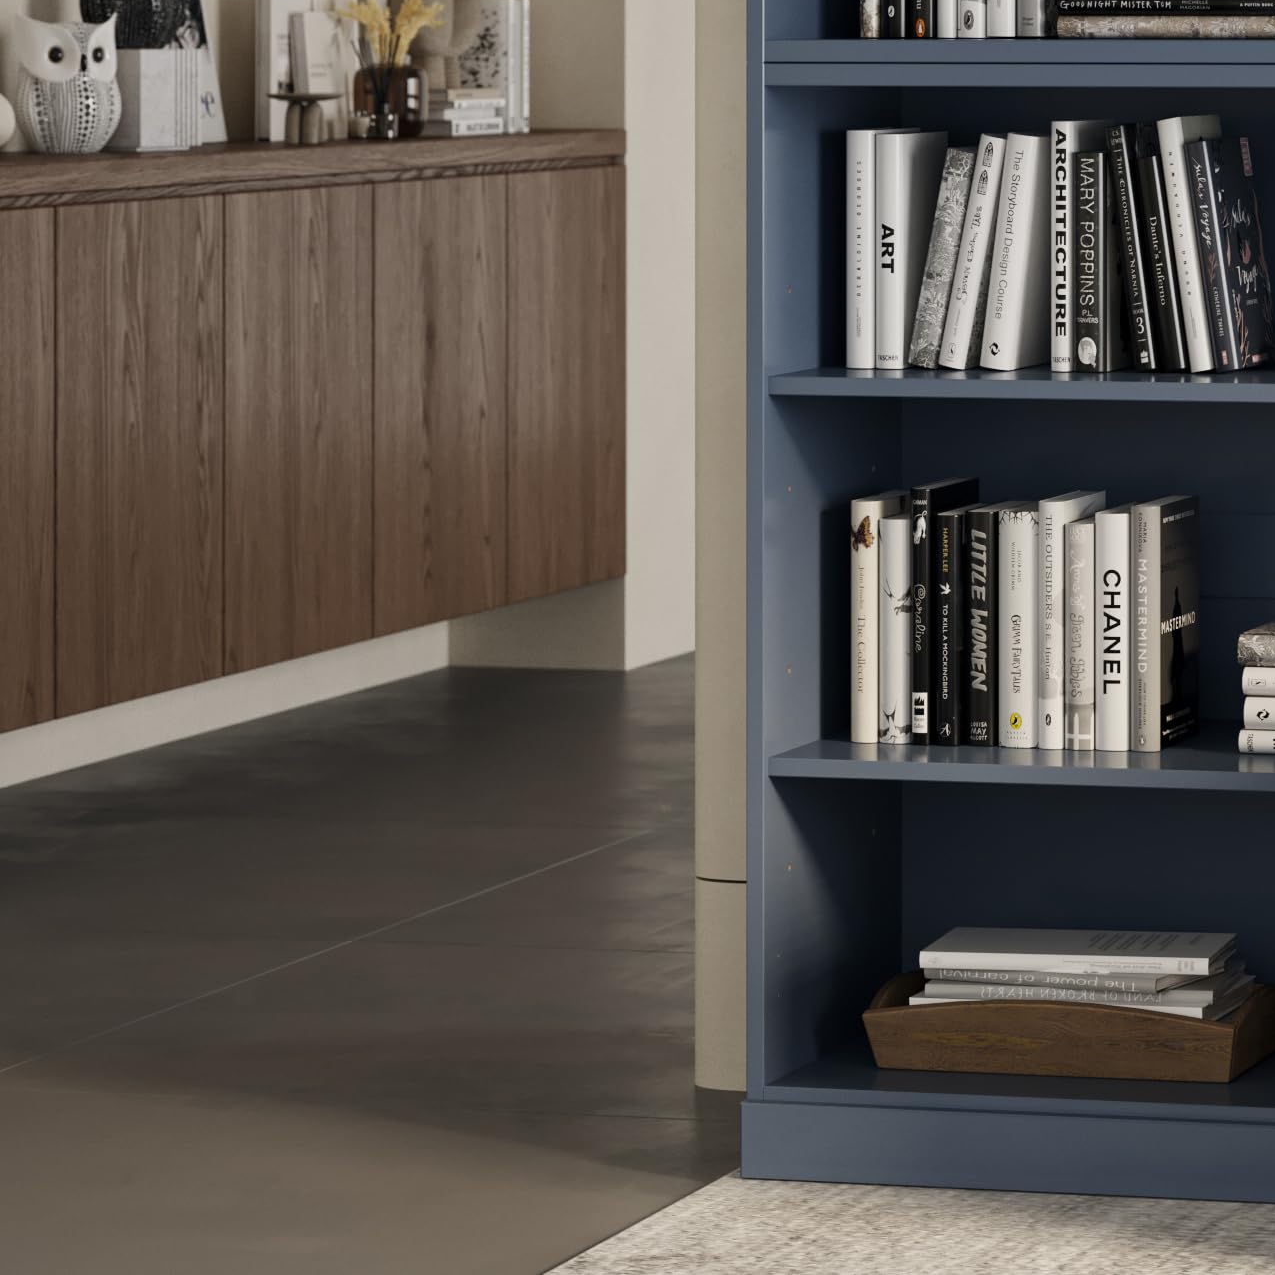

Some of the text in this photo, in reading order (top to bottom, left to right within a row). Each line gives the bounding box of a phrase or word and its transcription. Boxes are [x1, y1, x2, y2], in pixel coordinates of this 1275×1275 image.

[1120, 0, 1152, 9] MISTER
[1154, 0, 1172, 8] TOM
[881, 223, 895, 274] ART
[995, 149, 1024, 320] The Storyboard Design Course
[1055, 128, 1067, 337] ARCHITECTURE
[1080, 157, 1095, 306] MARY POPPINS
[1116, 156, 1140, 298] THE CHRONICLES OF NARNIA
[1197, 204, 1213, 249] Voyage
[1148, 216, 1168, 306] Dante's Inferno
[1135, 317, 1145, 334] 3
[1044, 514, 1053, 541] THE
[1044, 544, 1053, 620] OUTSIDERS
[857, 614, 866, 637] The
[913, 583, 927, 653] Coraline
[942, 604, 949, 615] TO
[970, 528, 988, 692] LITTLE WOMEN
[1010, 614, 1022, 645] GRIMM
[1070, 612, 1085, 654] Green
[1103, 569, 1121, 695] CHANEL
[1137, 558, 1148, 673] MASTERMIND
[1160, 611, 1196, 635] MASTERMIND
[857, 641, 866, 694] Collector
[1044, 646, 1053, 680] Hinton
[970, 727, 987, 735] MAY
[939, 968, 1136, 993] The power of carnival
